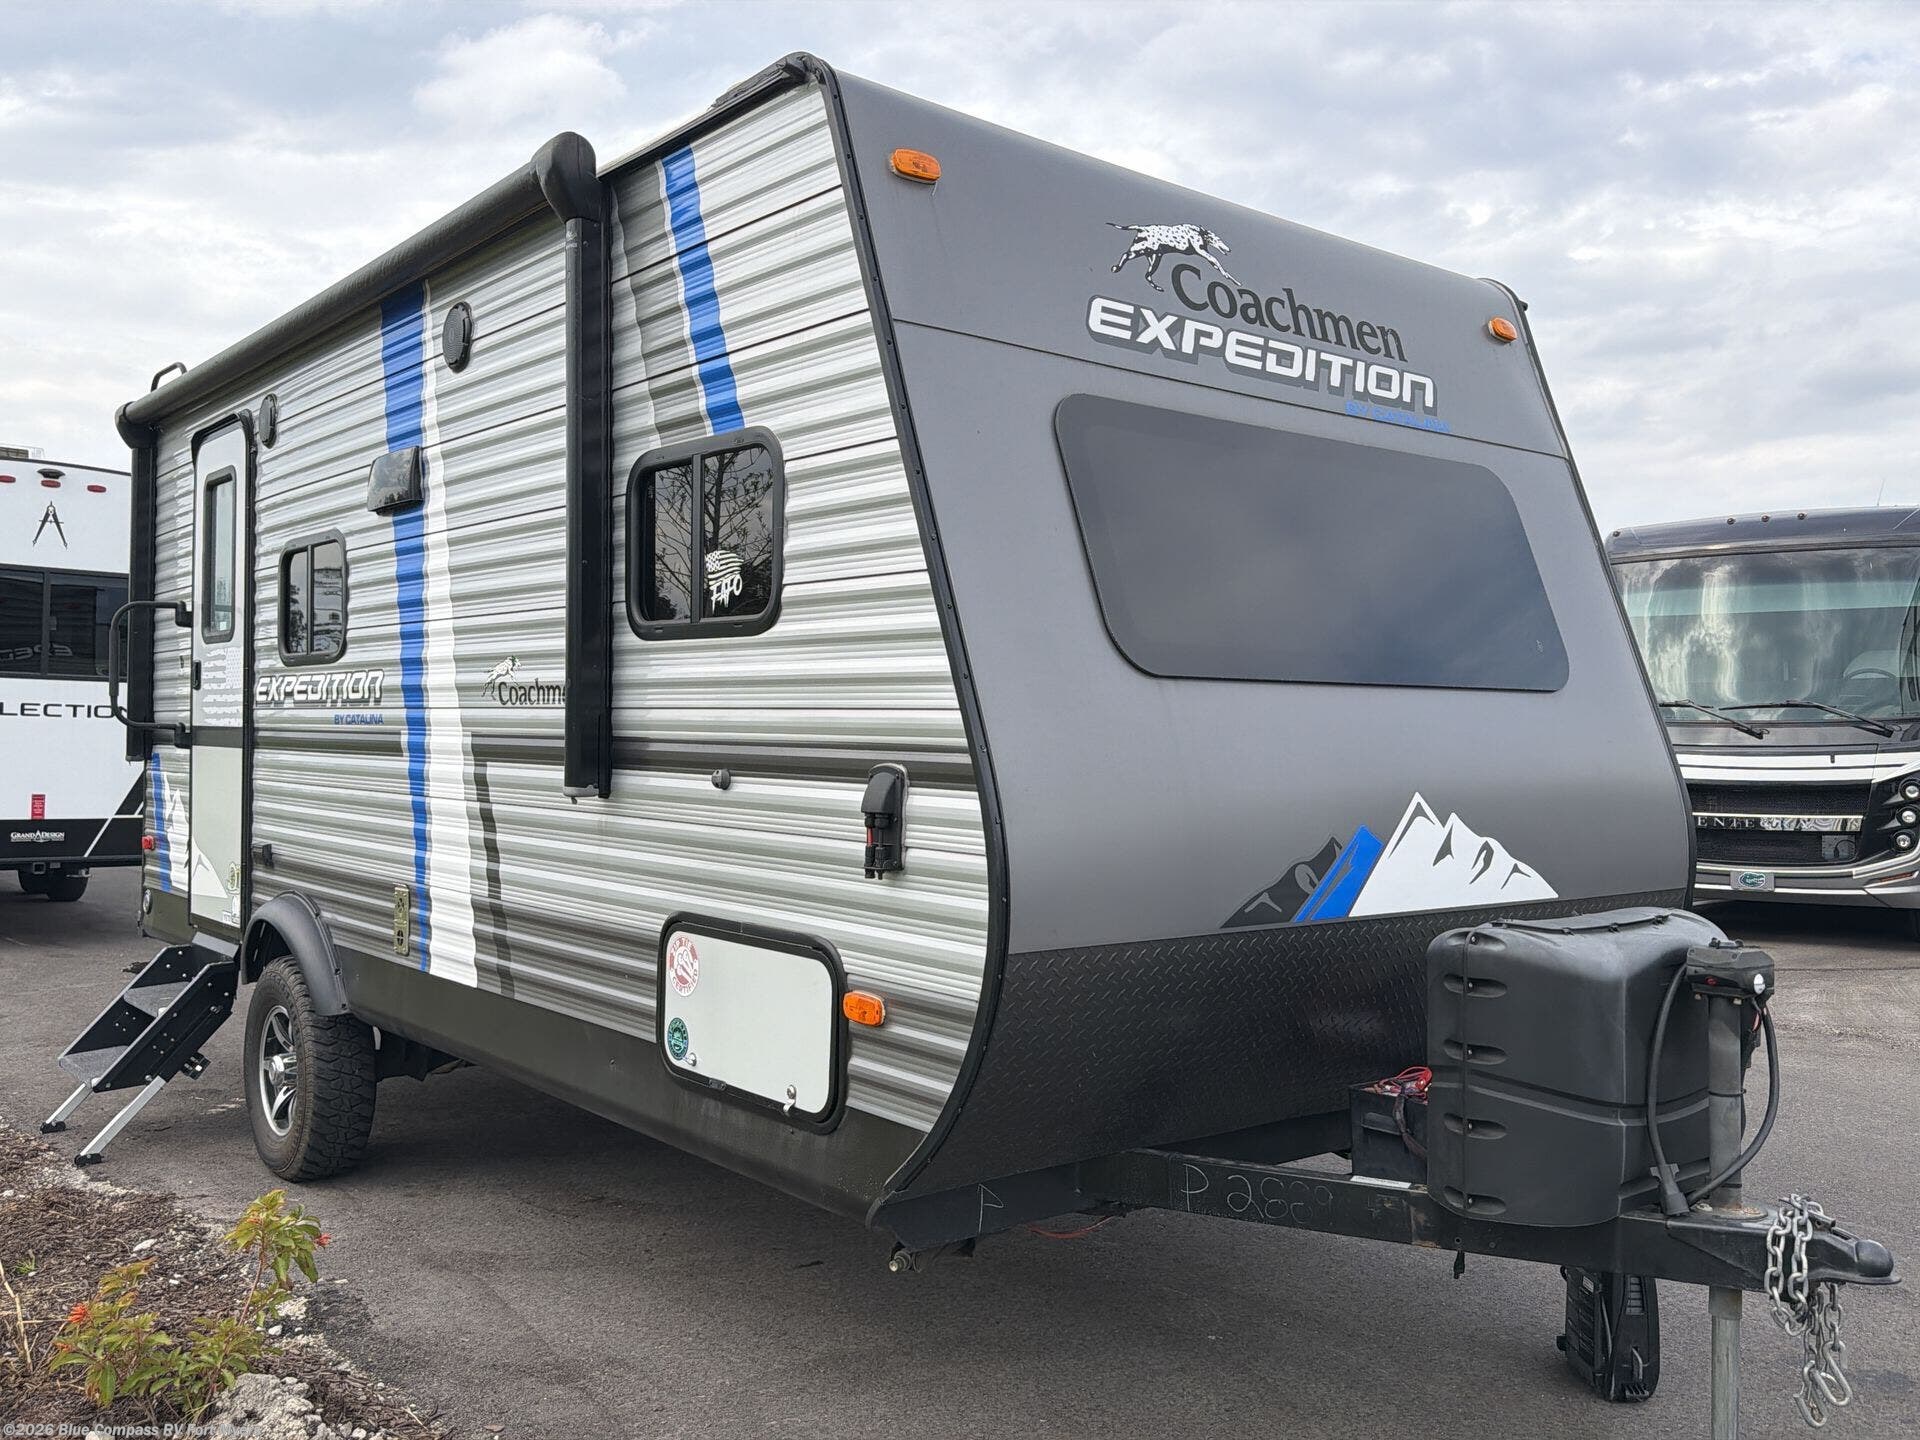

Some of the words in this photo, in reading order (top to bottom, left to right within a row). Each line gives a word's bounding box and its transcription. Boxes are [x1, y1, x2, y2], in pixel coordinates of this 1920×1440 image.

[1171, 263, 1408, 363] Coachmen
[1088, 296, 1436, 409] EXPEDITION
[256, 670, 384, 702] EXPEDITION
[334, 714, 344, 725] BY
[345, 713, 385, 725] CATALINA
[1180, 1163, 1210, 1212] P
